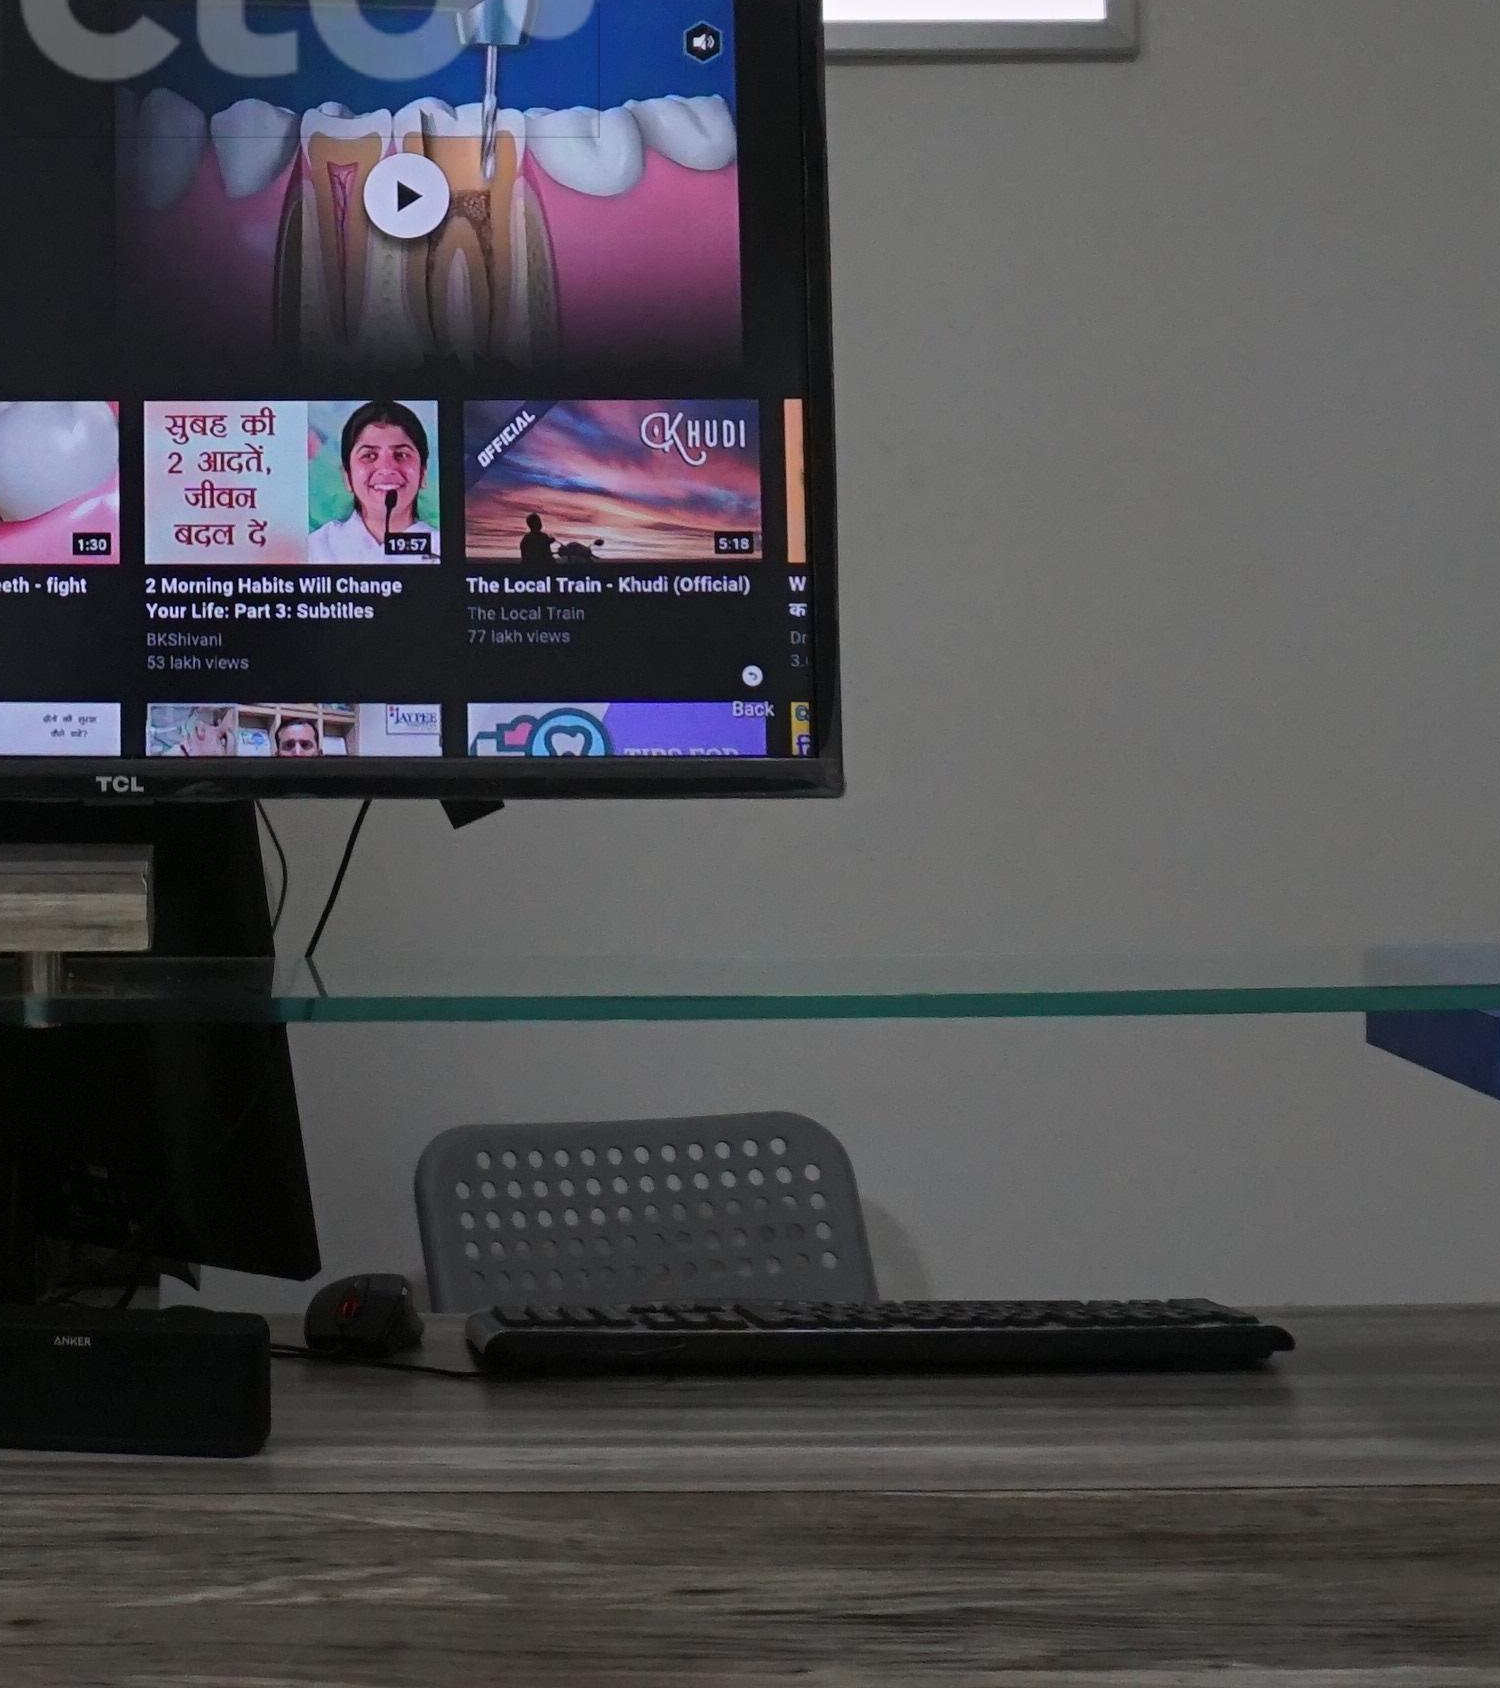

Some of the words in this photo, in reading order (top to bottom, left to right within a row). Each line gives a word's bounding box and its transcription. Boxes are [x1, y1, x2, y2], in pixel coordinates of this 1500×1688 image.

[164, 414, 228, 445] सुबह
[239, 406, 277, 436] की
[477, 410, 536, 469] OFFICIAL
[167, 451, 183, 474] 2
[197, 442, 272, 476] आदतें,
[183, 479, 258, 509] जीवन
[78, 539, 107, 551] 1:30
[173, 524, 236, 548] बदल
[389, 538, 427, 551] 19:57
[718, 537, 751, 551] 5:18
[46, 576, 87, 597] fight
[145, 577, 157, 594] 2
[161, 576, 234, 598] Morning
[237, 576, 295, 594] Habits
[298, 576, 332, 594] Will
[335, 576, 403, 598] Change
[465, 576, 500, 594] The
[503, 575, 551, 594] Local
[555, 575, 602, 593] Train
[618, 575, 669, 593] Khudi
[673, 575, 751, 596] (Official)
[145, 602, 187, 619] Your
[191, 601, 229, 619] Life:
[234, 602, 271, 619] Part
[275, 603, 292, 619] 3:
[296, 601, 375, 619] Subtitles
[146, 631, 222, 647] BKShivani
[732, 700, 776, 717] Back
[95, 775, 145, 793] TCL
[53, 1335, 92, 1347] ANKER
